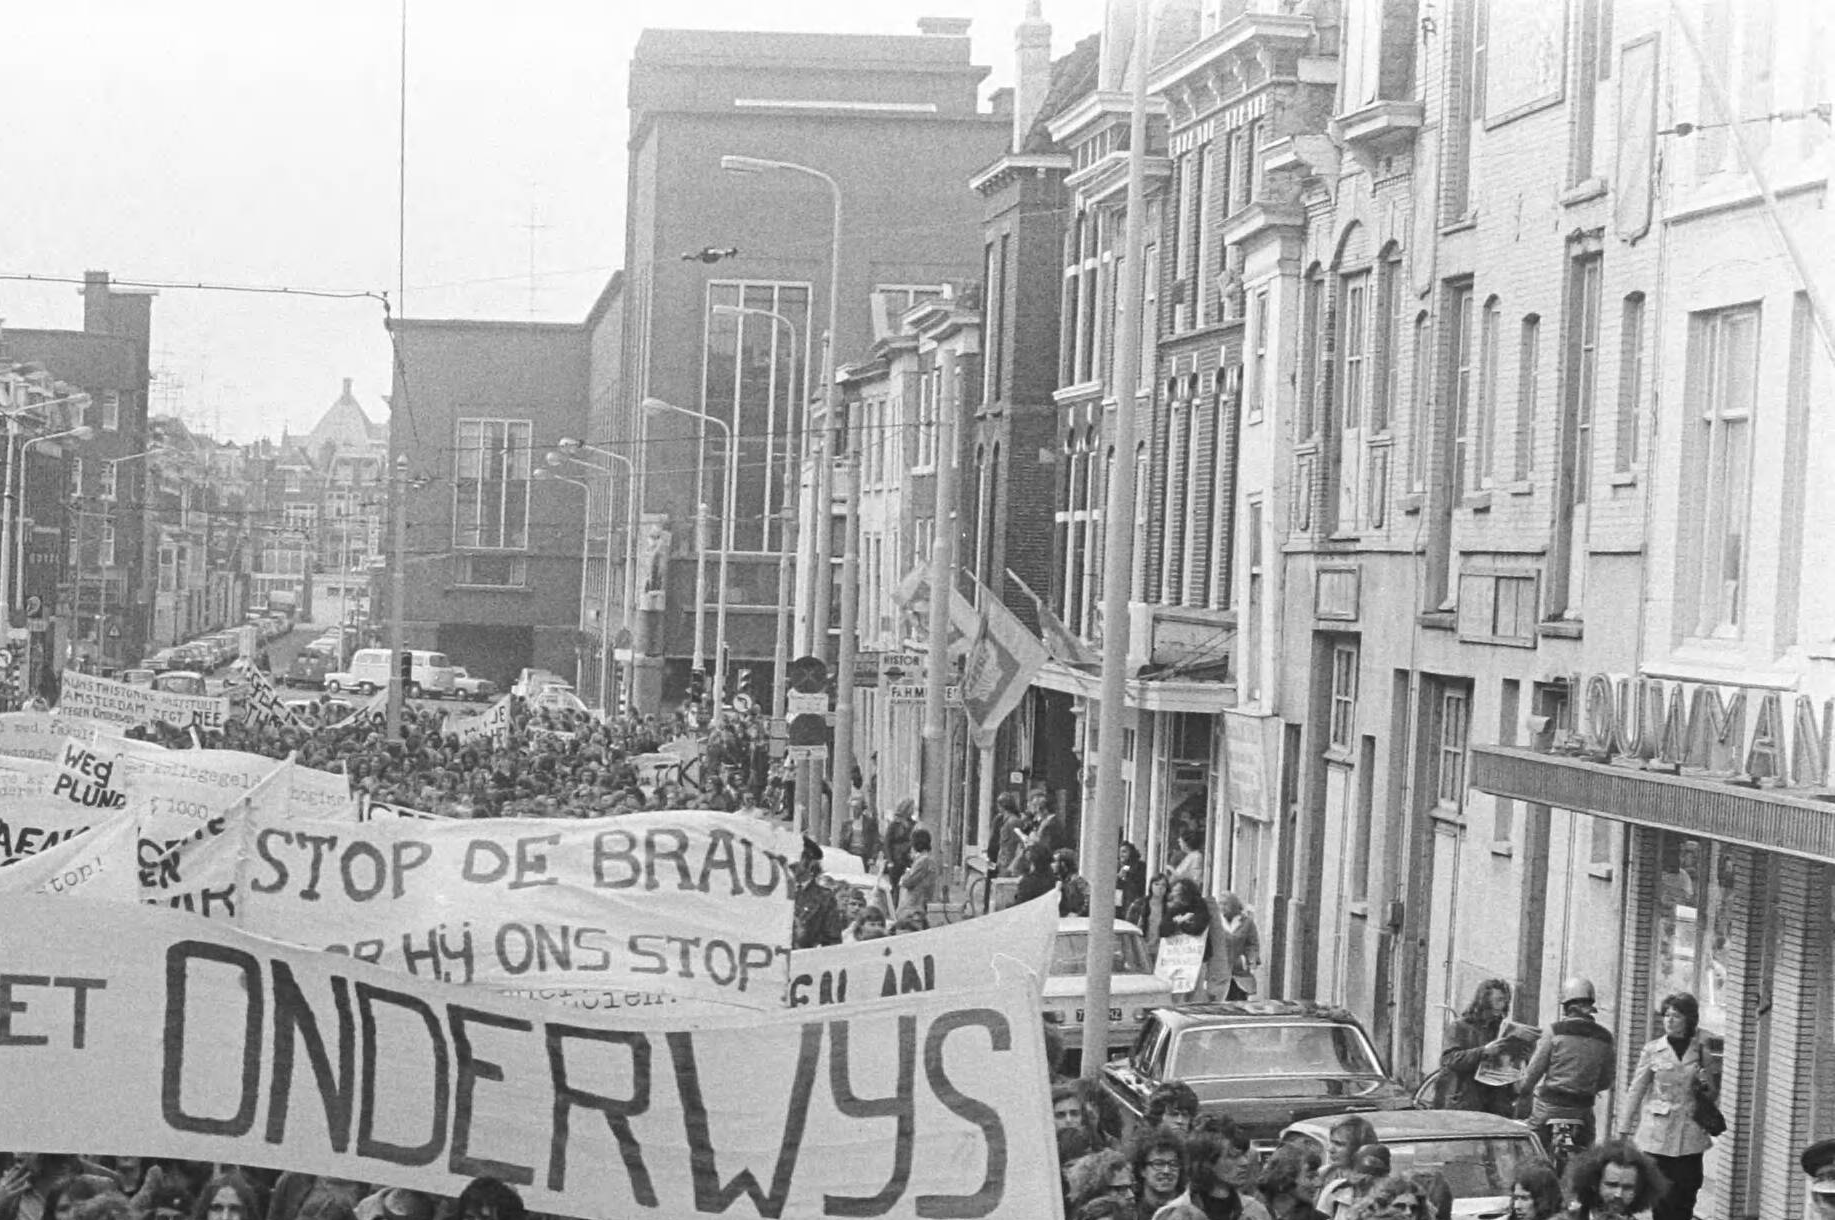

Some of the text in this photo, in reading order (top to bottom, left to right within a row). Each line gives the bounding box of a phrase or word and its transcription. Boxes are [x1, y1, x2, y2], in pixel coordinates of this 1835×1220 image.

[250, 828, 432, 903] STOP
[463, 832, 562, 889] DE
[494, 922, 611, 973] ONS
[162, 939, 1013, 1220] ONDERWYS
